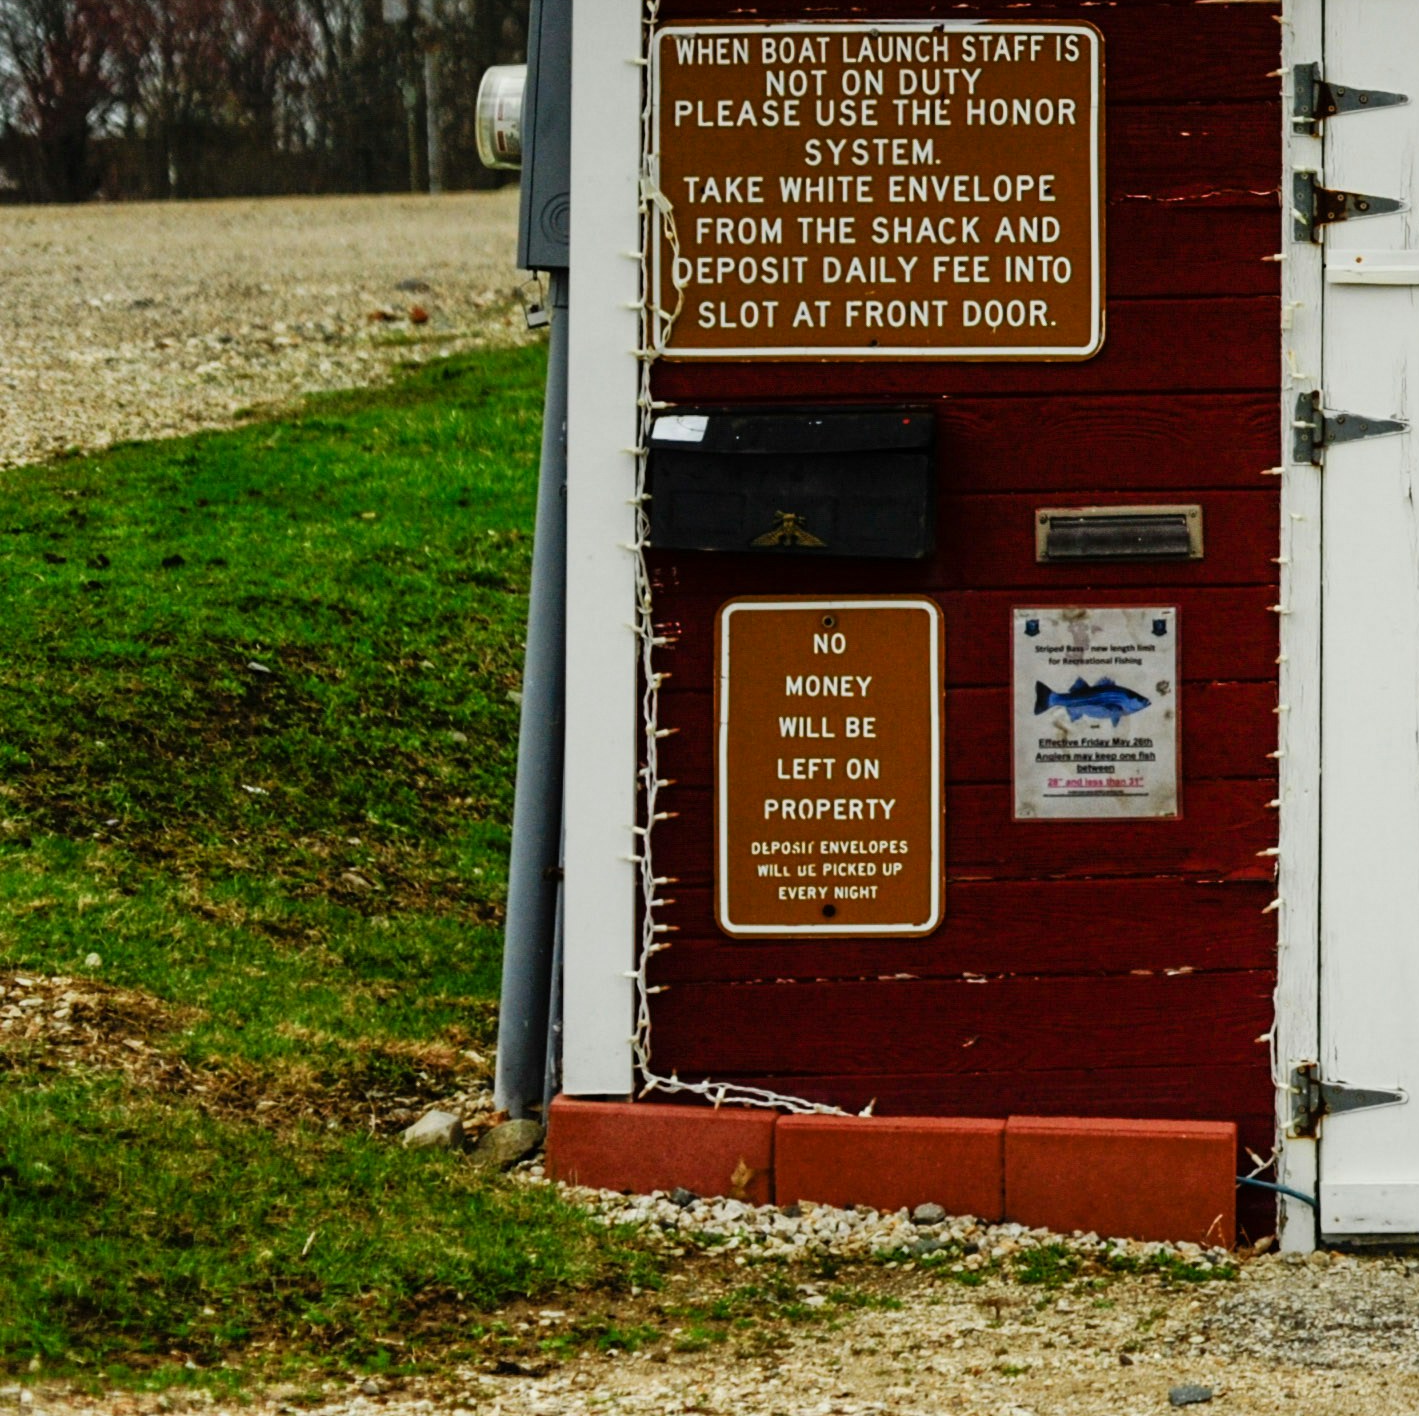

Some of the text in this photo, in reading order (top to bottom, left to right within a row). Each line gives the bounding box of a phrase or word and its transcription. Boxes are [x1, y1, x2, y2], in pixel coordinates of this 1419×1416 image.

[676, 35, 1080, 65] WHEN BOAT LAUNCH STAFF IS
[766, 68, 982, 97] NOT ON DUTY
[674, 98, 1076, 127] PLEASE USE THE HONOR
[804, 138, 941, 166] SYSTEM.
[683, 175, 1056, 203] TAKE WHITE ENVELOPE
[696, 216, 1060, 244] FROM THE SHACK AND
[675, 255, 1071, 284] DEPOSIT DAILY FEE INTO
[698, 300, 1057, 328] SLOT AT FRONT DOOR.
[813, 633, 846, 654] NO
[1035, 644, 1064, 655] Striped
[1110, 644, 1135, 654] length
[1137, 644, 1155, 653] limit
[1048, 657, 1142, 666] for Recreational Fishing
[785, 675, 872, 697] MONEY
[779, 716, 876, 738] WILL BE
[1038, 738, 1078, 748] Effective
[1081, 738, 1110, 748] Friday
[1112, 738, 1131, 748] May
[1035, 752, 1156, 762] Anglers may keep one fish
[777, 758, 879, 779] LEFT ON
[1076, 764, 1115, 774] between
[1065, 778, 1082, 787] and
[1085, 778, 1103, 787] less
[1106, 778, 1126, 787] than
[764, 798, 896, 820] PROPERTY
[820, 840, 909, 854] ENVELOPES
[822, 862, 877, 877] PICKED
[882, 862, 903, 876] UP
[778, 885, 878, 900] EVERY NIGHT
